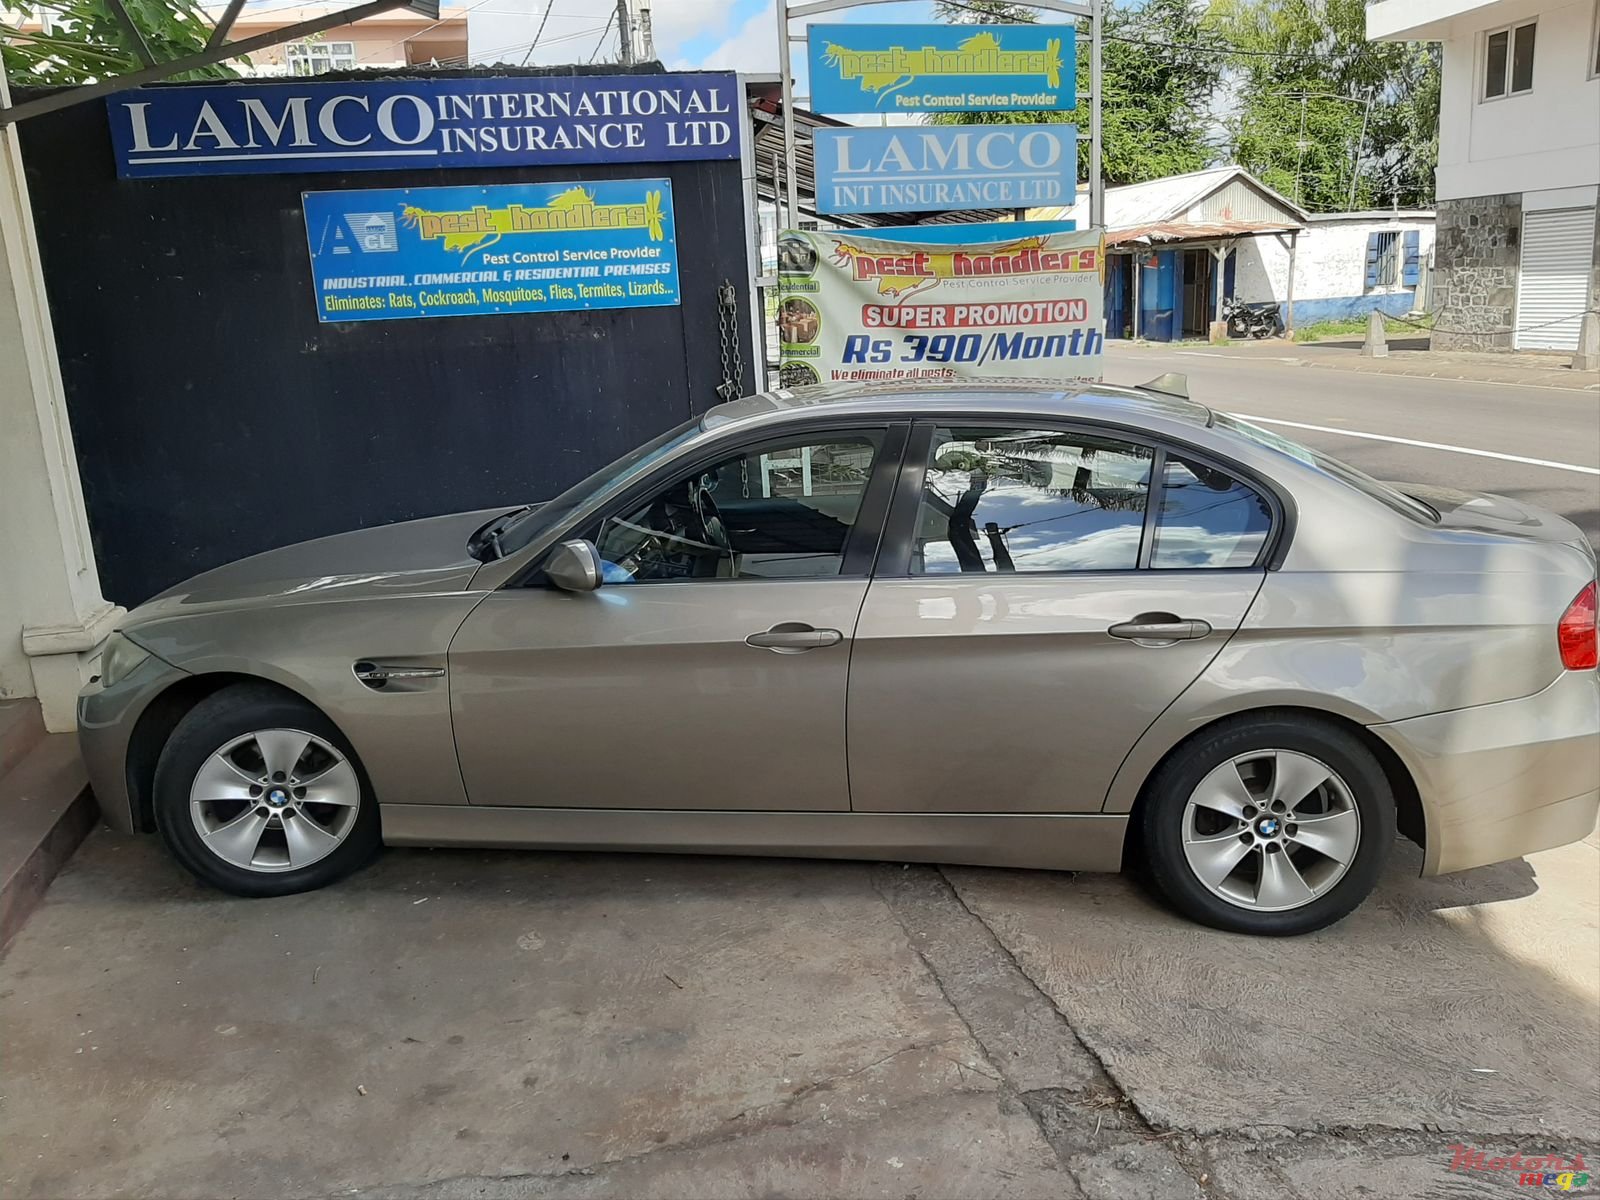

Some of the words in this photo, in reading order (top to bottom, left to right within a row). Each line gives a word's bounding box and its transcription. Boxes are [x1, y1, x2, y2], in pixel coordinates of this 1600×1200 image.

[436, 88, 730, 121] INTERNATIONAL
[896, 94, 920, 106] Pest
[922, 93, 966, 106] Control
[968, 93, 1009, 106] Service
[1011, 92, 1057, 105] Provider
[121, 95, 435, 153] LAMCO
[440, 122, 646, 153] INSURANCE
[665, 121, 731, 147] LTD
[831, 131, 1061, 174] LAMCO
[833, 185, 874, 207] INT
[881, 180, 1013, 206] INSURANCE
[1019, 179, 1061, 201] LTD
[421, 207, 497, 239] pest
[510, 203, 647, 231] handlers
[483, 252, 510, 265] Pest
[512, 251, 560, 264] Control
[563, 248, 608, 262] Service
[610, 247, 661, 260] Provider
[855, 253, 935, 279] pest
[953, 250, 1096, 276] handlers
[414, 271, 500, 286] COMMERCIAL
[503, 270, 512, 283] &
[515, 266, 601, 281] RESIDENTIAL
[604, 263, 671, 276] PREMISES
[779, 282, 817, 291] esidential
[943, 280, 966, 289] Pest
[968, 278, 1009, 289] Control
[1012, 276, 1051, 286] Service
[1053, 274, 1094, 284] Provider
[324, 295, 386, 311] Eliminates:
[389, 292, 416, 309] Rats,
[419, 289, 480, 306] Cockroach,
[482, 288, 547, 305] Mosquitoes,
[549, 284, 577, 301] Flies,
[577, 282, 626, 298] Termites,
[866, 306, 947, 327] SUPER
[953, 301, 1084, 326] PROMOTION
[780, 348, 819, 356] ommercial
[841, 335, 893, 363] Rs
[900, 328, 1103, 367] 390/Month
[831, 369, 849, 381] We
[850, 368, 904, 380] eliminate
[905, 367, 919, 378] all
